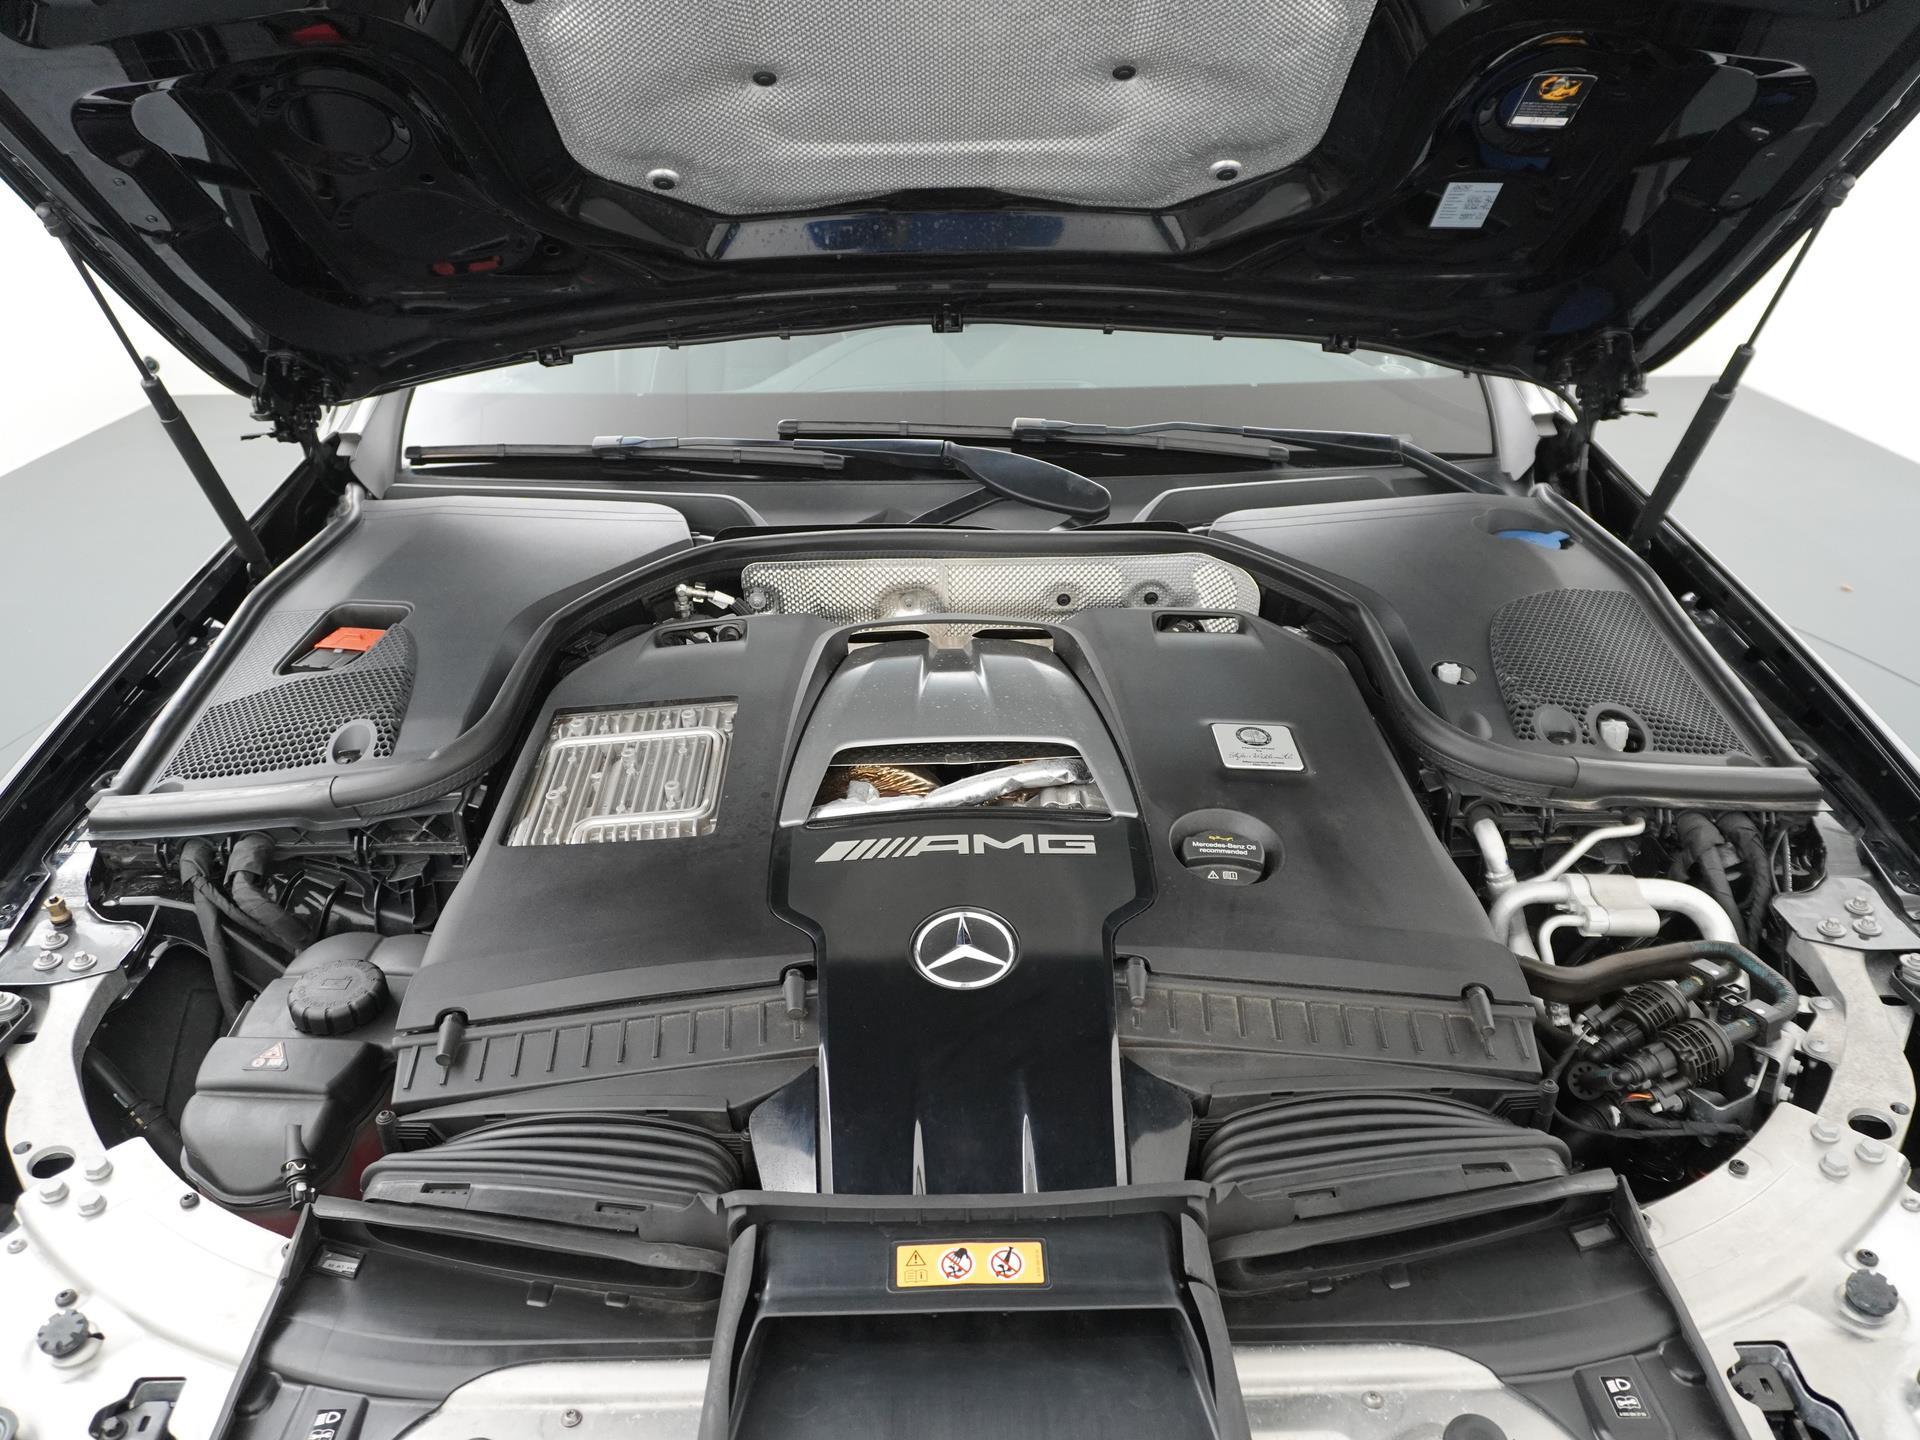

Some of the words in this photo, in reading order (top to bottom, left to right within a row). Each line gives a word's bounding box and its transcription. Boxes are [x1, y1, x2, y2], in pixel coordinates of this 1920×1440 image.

[904, 834, 1097, 857] AMG
[1192, 841, 1246, 850] Mercedes-Benz
[1199, 848, 1248, 856] recommended
